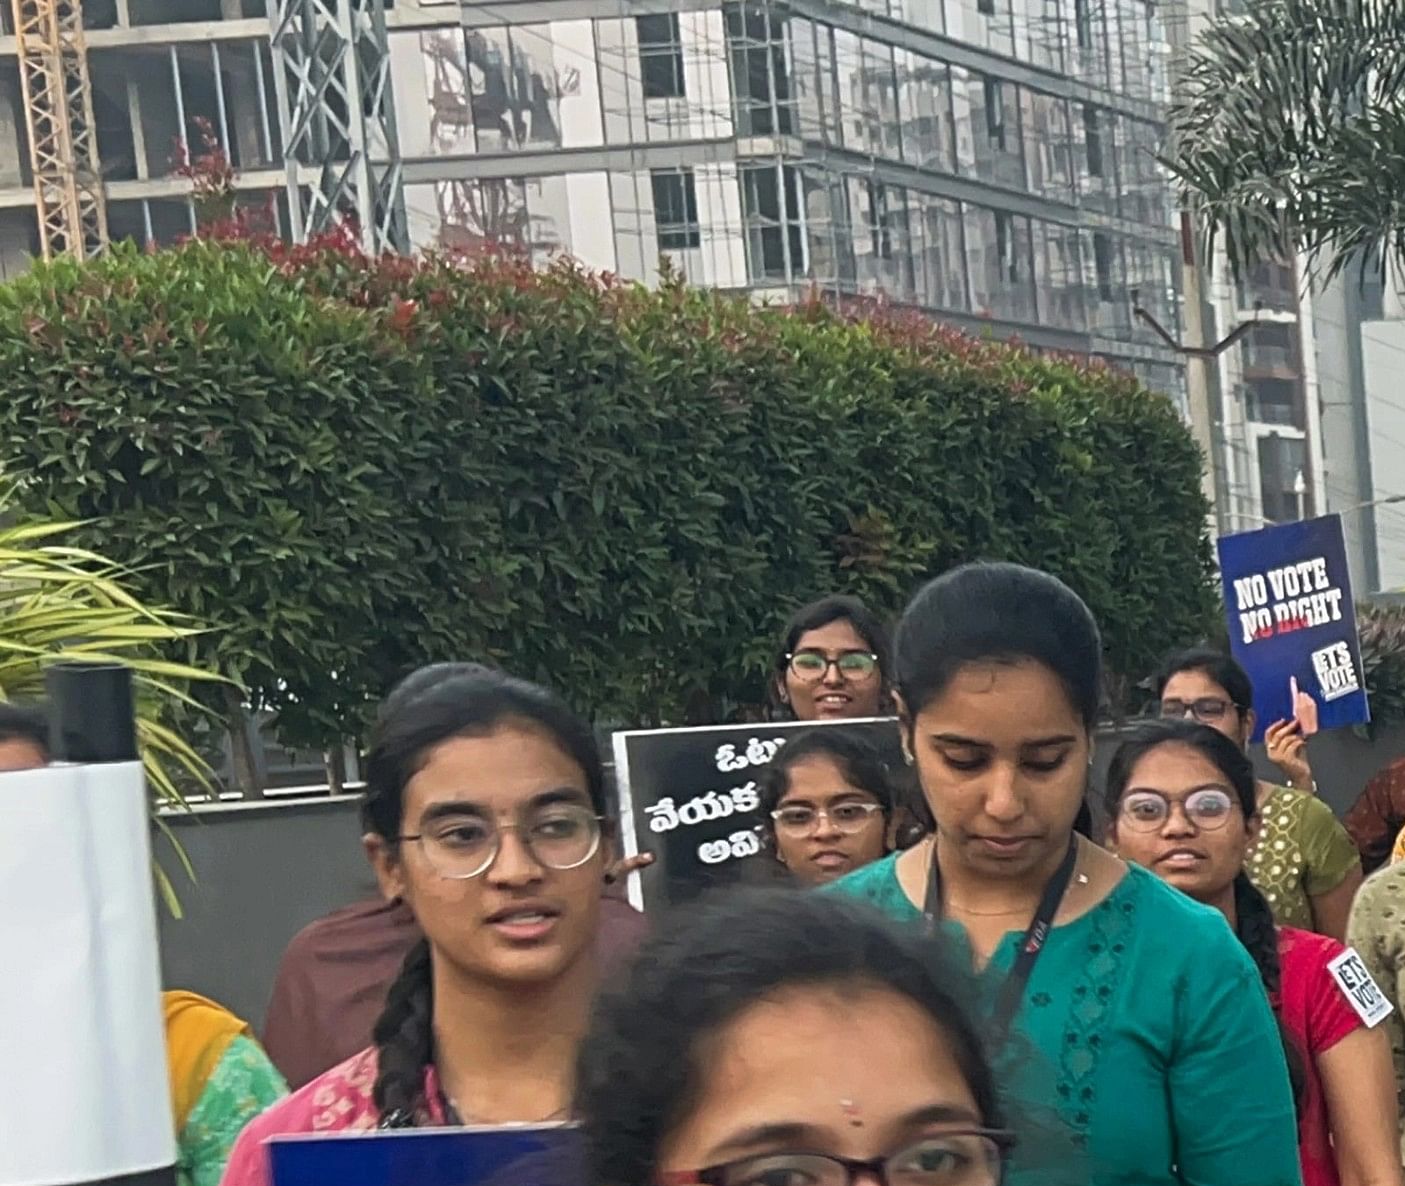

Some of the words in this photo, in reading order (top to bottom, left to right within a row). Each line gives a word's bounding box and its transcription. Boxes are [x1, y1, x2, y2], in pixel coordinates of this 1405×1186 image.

[1233, 574, 1267, 610] NO
[1267, 557, 1329, 600] VOTE
[1239, 608, 1273, 644] NO
[1273, 588, 1342, 633] RIGHT
[1317, 664, 1357, 692] VOTE
[1351, 979, 1381, 1009] VOTE
